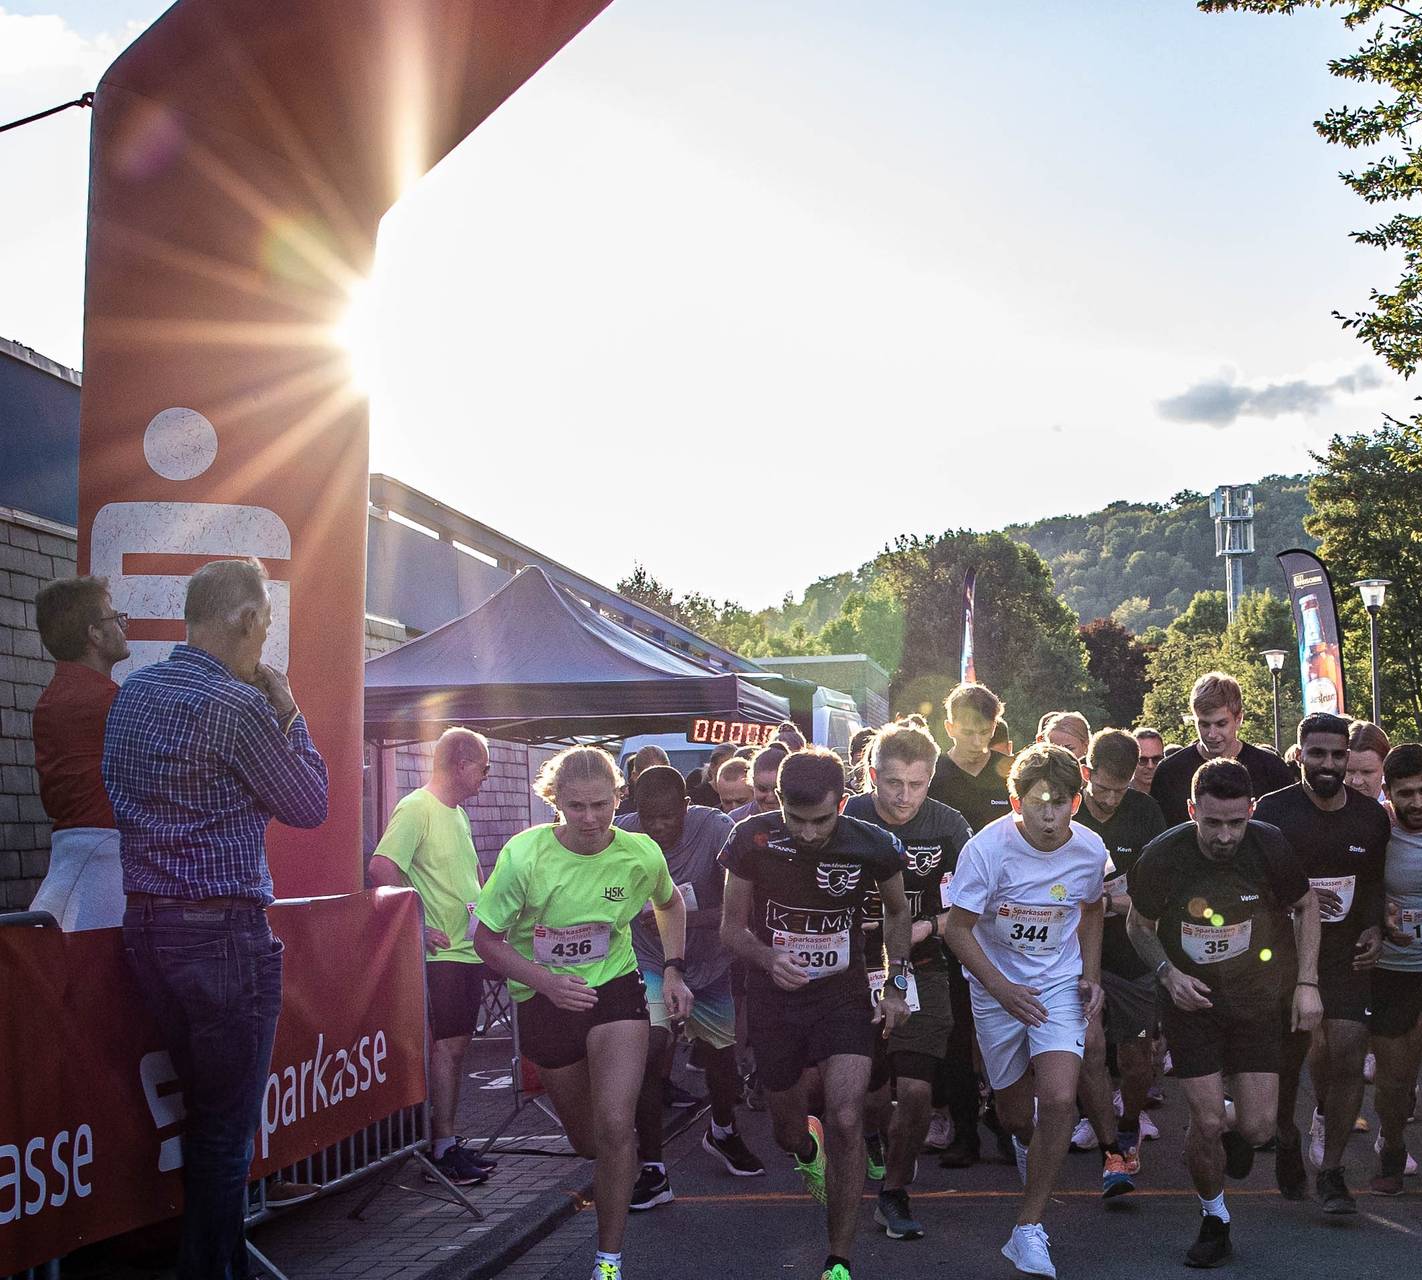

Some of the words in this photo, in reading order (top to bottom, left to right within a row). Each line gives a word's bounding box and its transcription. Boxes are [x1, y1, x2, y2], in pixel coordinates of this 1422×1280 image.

[604, 887, 625, 897] HSK
[1012, 906, 1052, 917] Sparkassen
[788, 934, 832, 943] Sparkassen
[1010, 923, 1049, 943] 344
[551, 939, 592, 957] 436
[1204, 939, 1229, 955] 35
